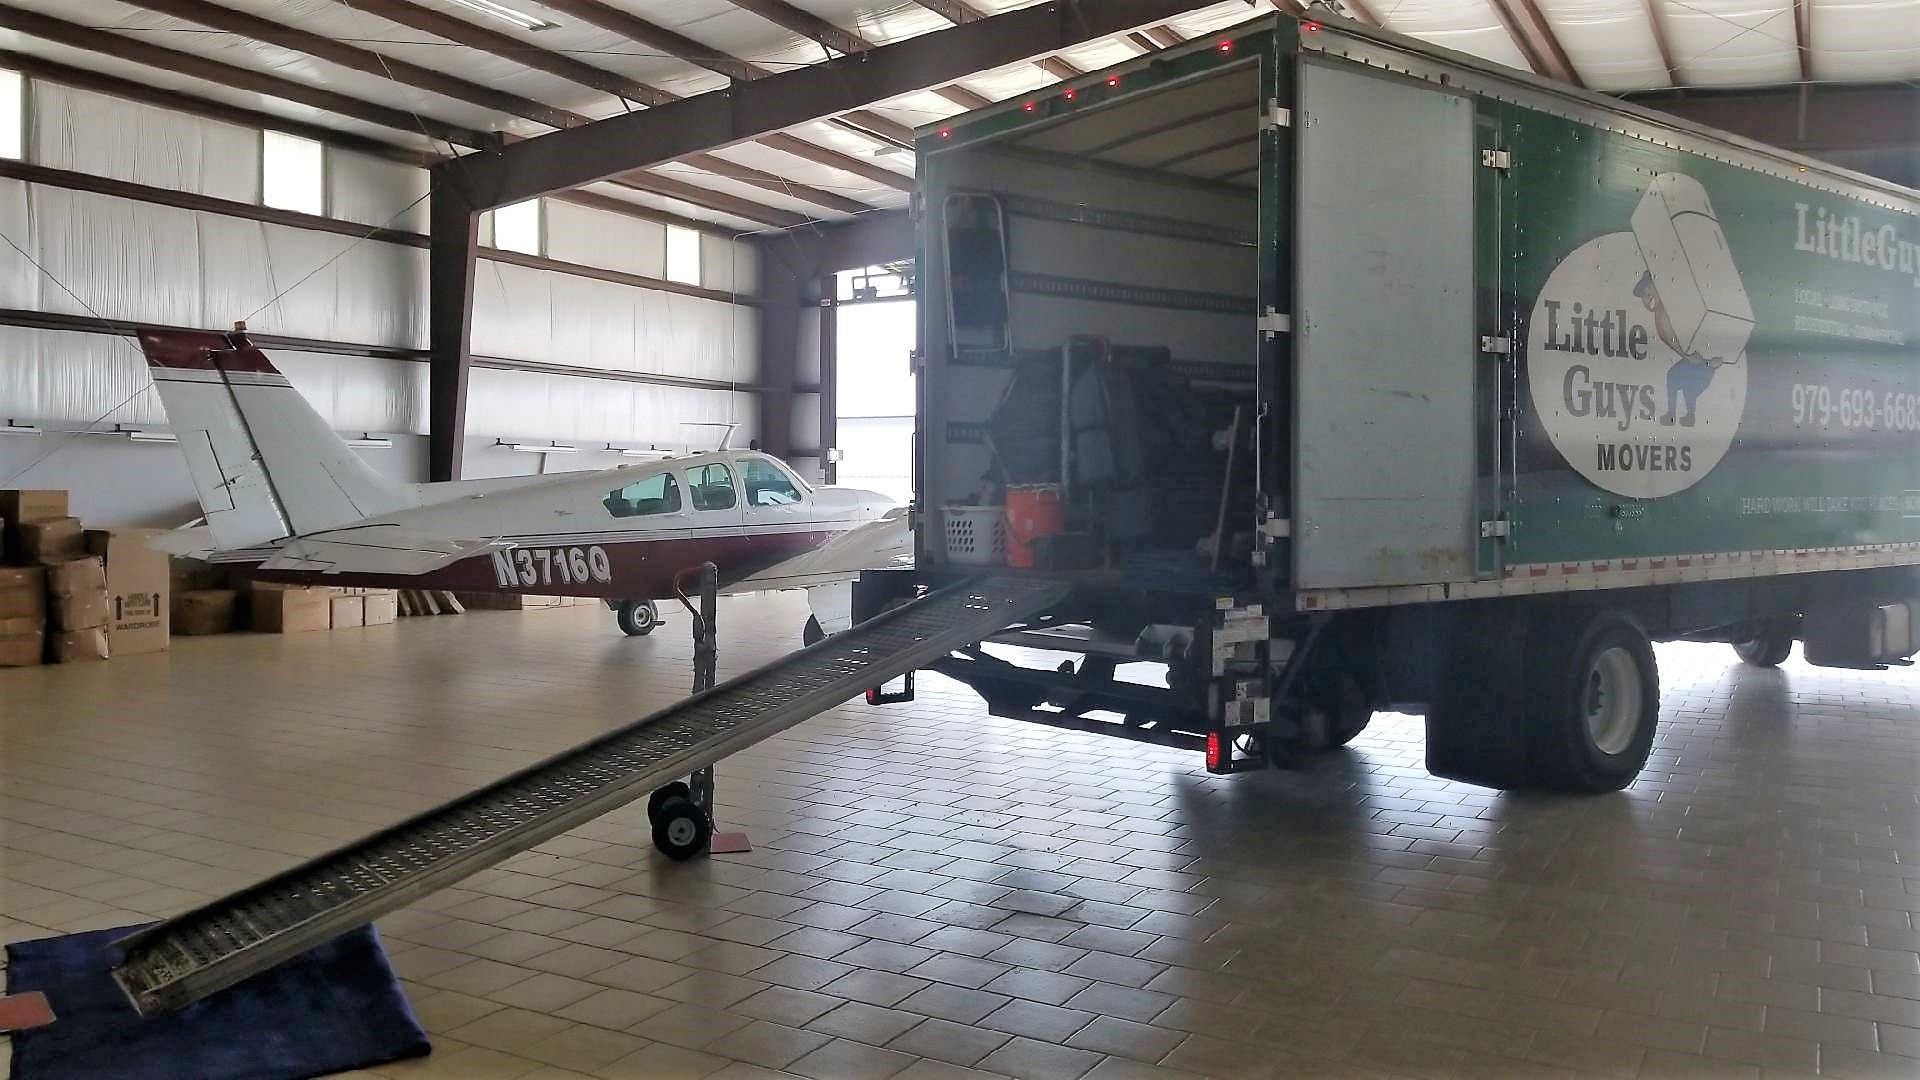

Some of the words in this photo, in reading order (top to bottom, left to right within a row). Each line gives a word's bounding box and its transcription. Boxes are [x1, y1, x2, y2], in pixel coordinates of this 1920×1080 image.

[1544, 300, 1648, 360] Little
[1563, 365, 1655, 431] Guys
[1597, 444, 1691, 471] MOVERS
[492, 545, 611, 587] N3716Q
